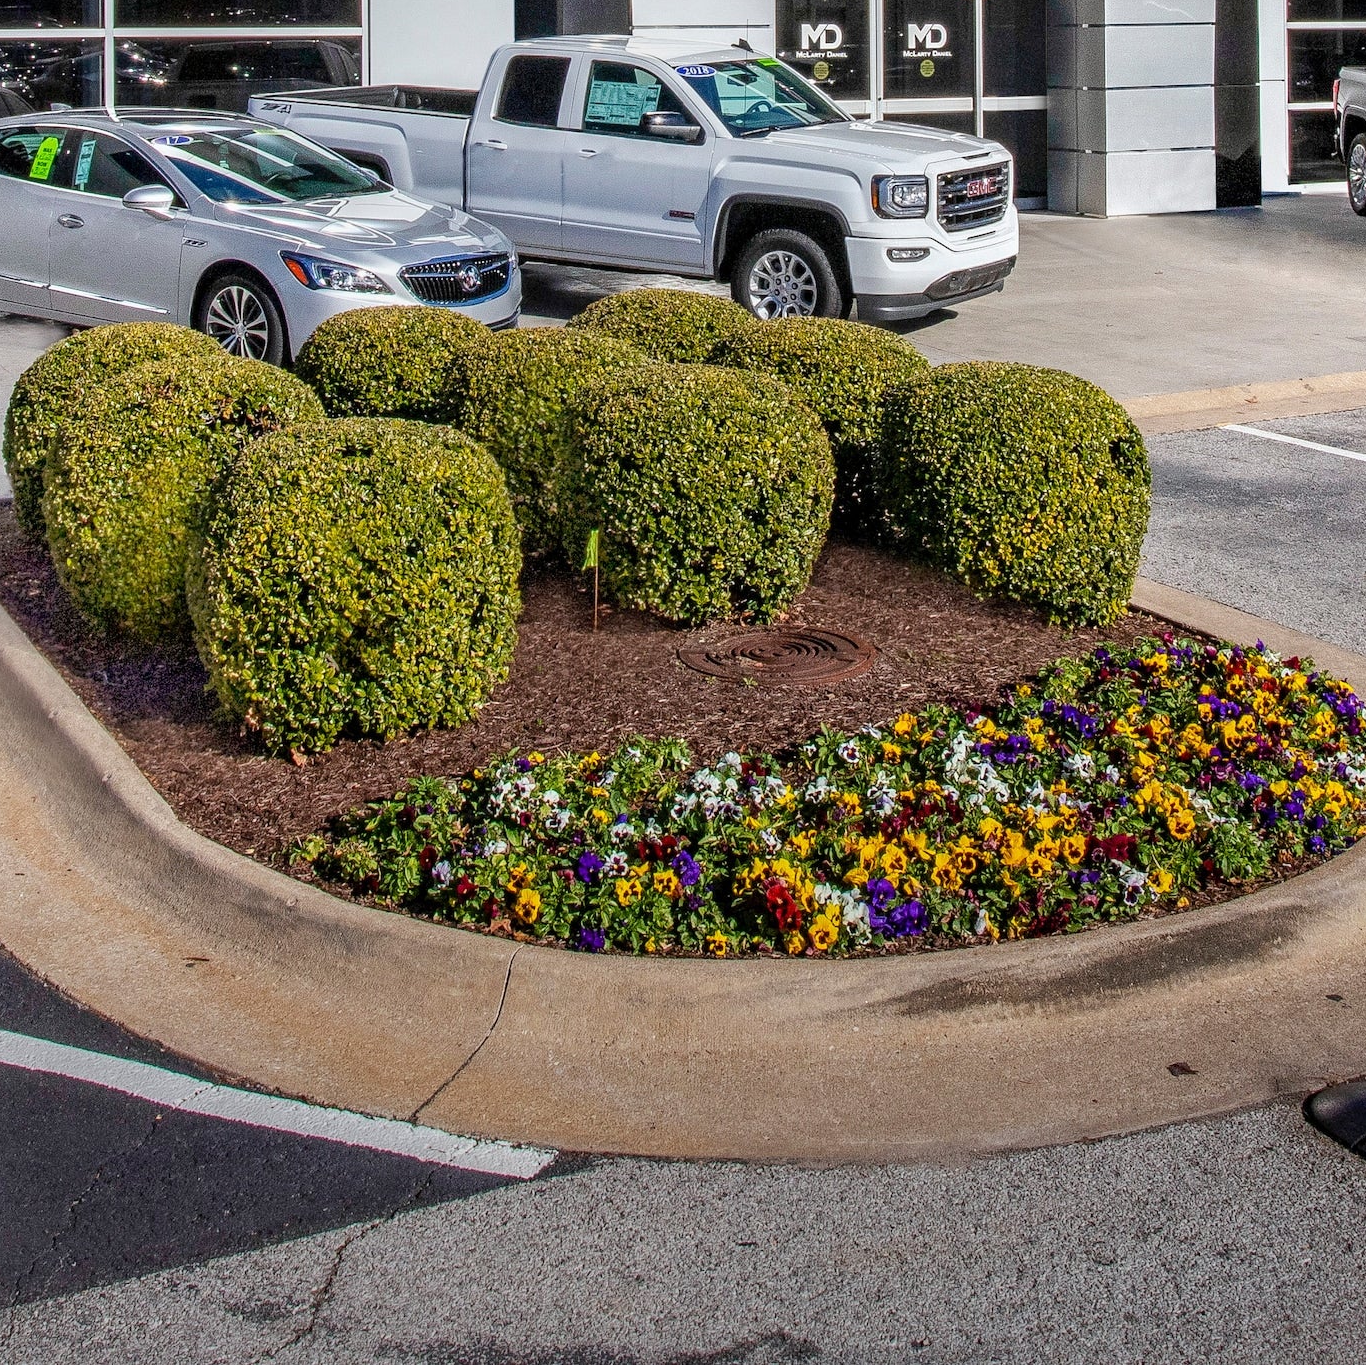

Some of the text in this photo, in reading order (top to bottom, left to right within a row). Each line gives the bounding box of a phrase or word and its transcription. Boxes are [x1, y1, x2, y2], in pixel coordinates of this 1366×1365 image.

[801, 23, 843, 50] MD
[907, 23, 948, 49] MD
[684, 66, 710, 75] 2018
[967, 177, 998, 198] GMC
